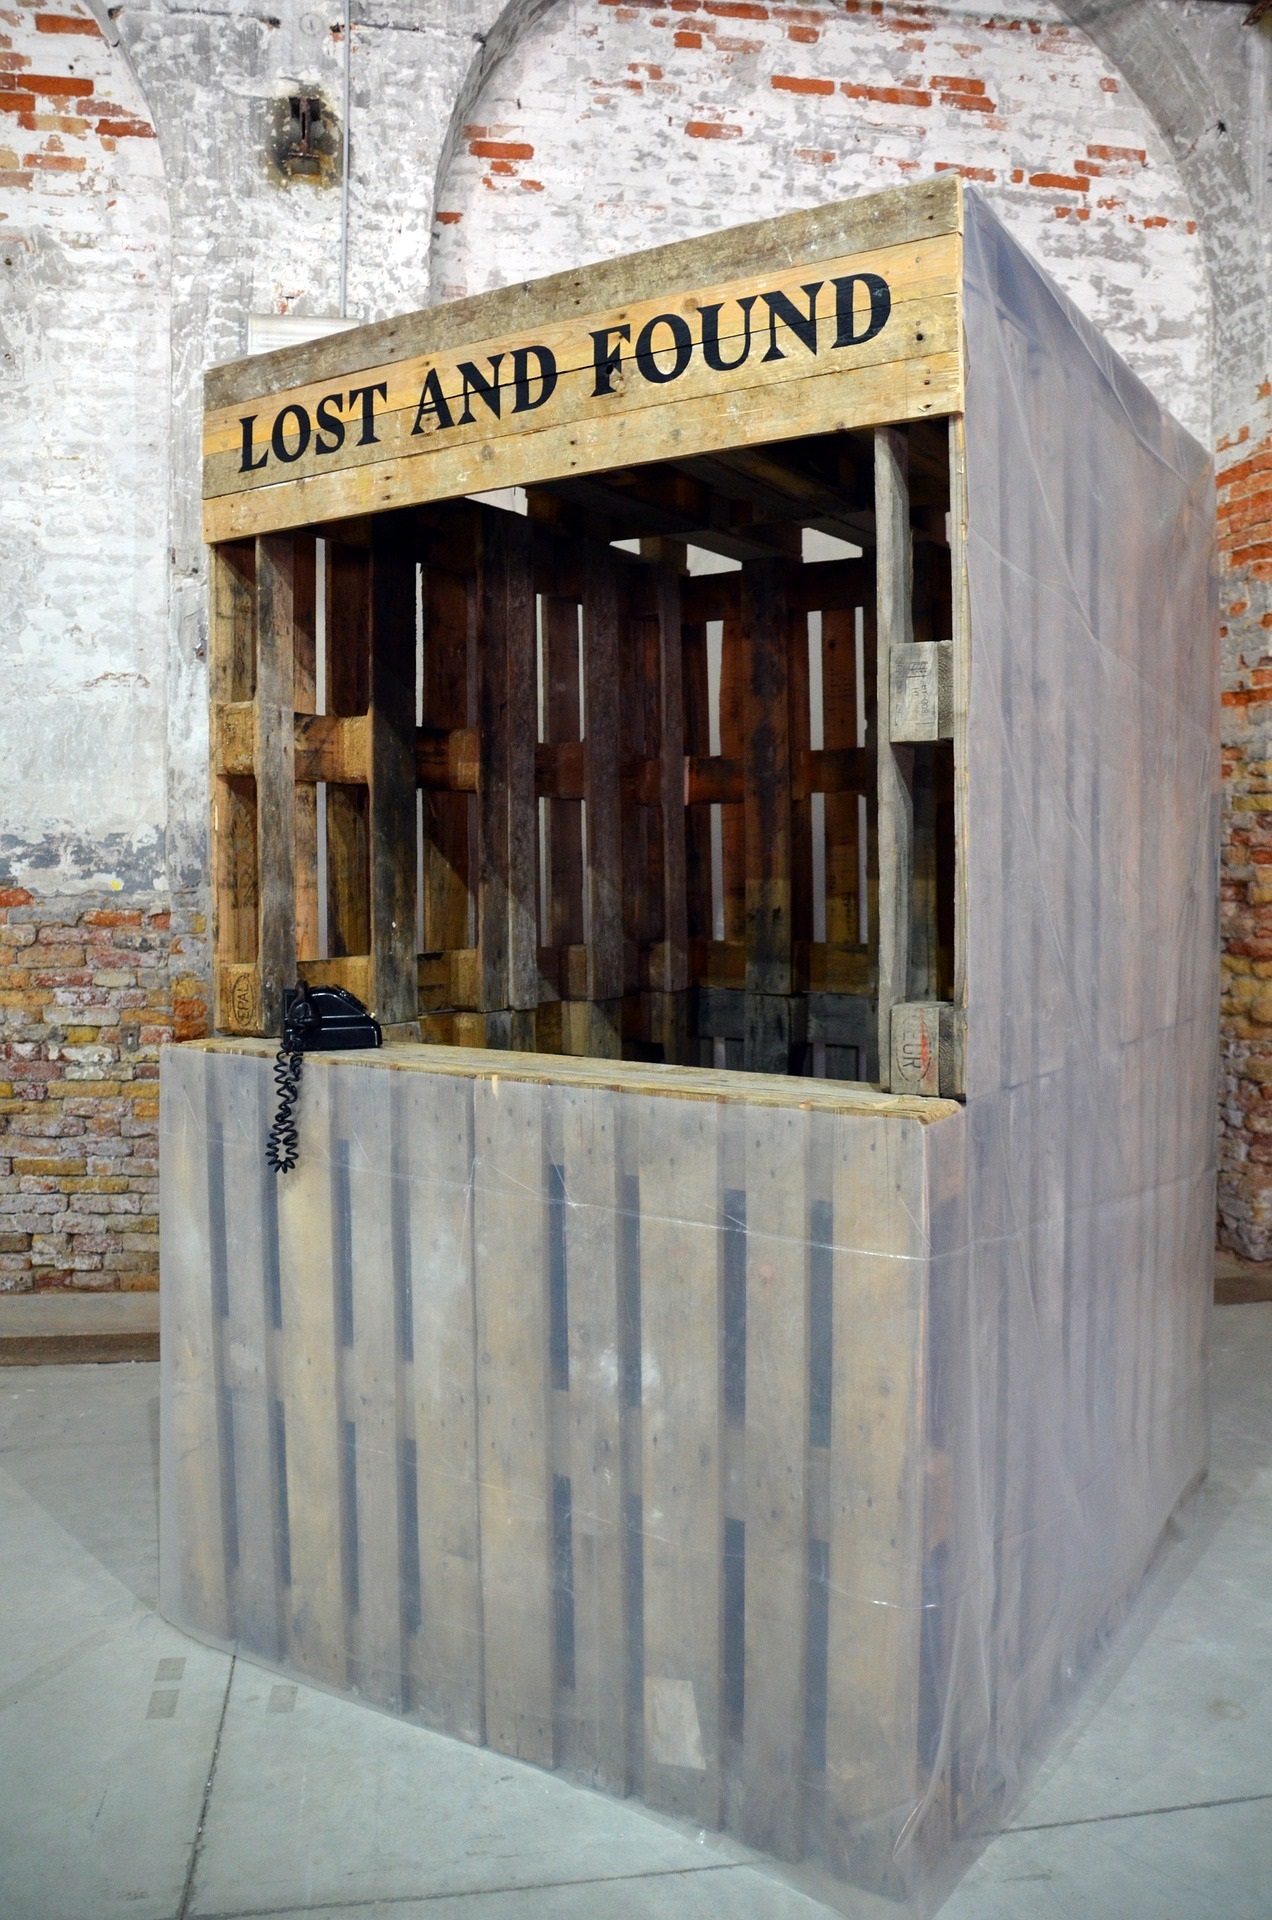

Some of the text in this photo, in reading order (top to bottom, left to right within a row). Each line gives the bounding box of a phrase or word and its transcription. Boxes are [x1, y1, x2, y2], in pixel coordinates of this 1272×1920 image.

[238, 272, 891, 473] LOST AND FOUND
[237, 984, 250, 1020] EPAL
